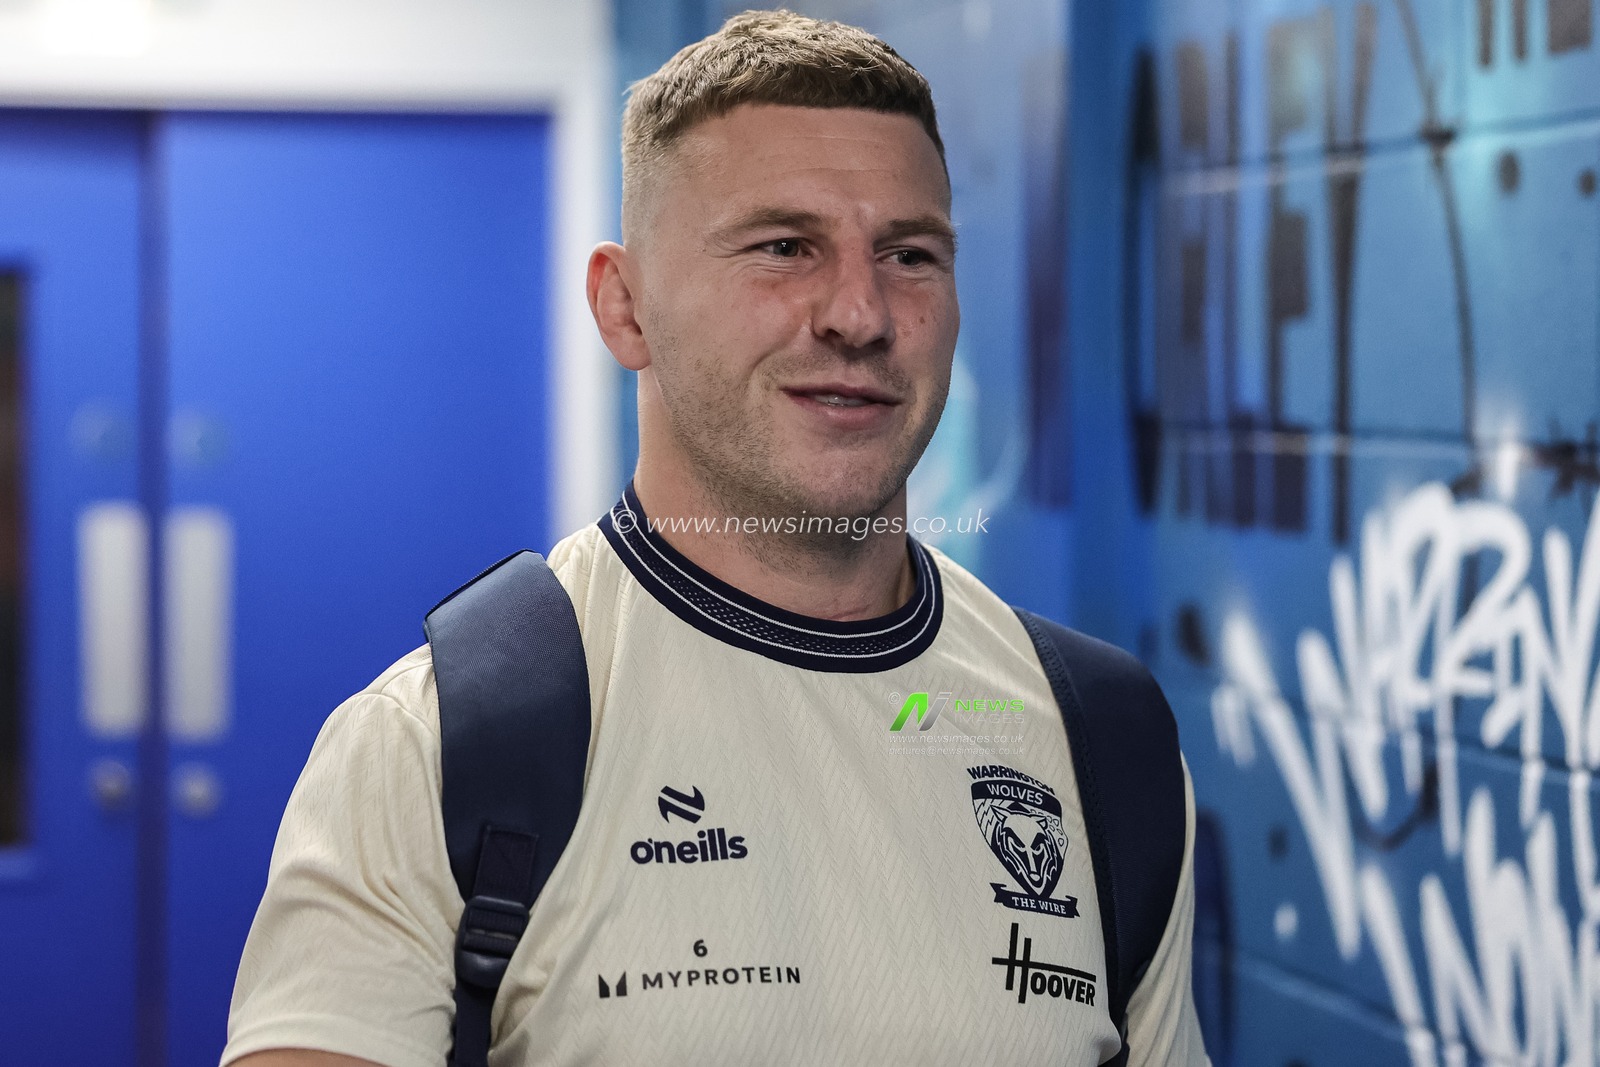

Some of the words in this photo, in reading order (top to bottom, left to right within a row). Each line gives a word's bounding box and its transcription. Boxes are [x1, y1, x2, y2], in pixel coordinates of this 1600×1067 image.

[966, 765, 1055, 796] WARRINGTON
[986, 783, 1044, 806] WOLVES
[1011, 896, 1037, 909] THE
[1039, 899, 1067, 915] WIRE
[693, 939, 708, 958] 6
[642, 966, 801, 990] MYPROTEIN
